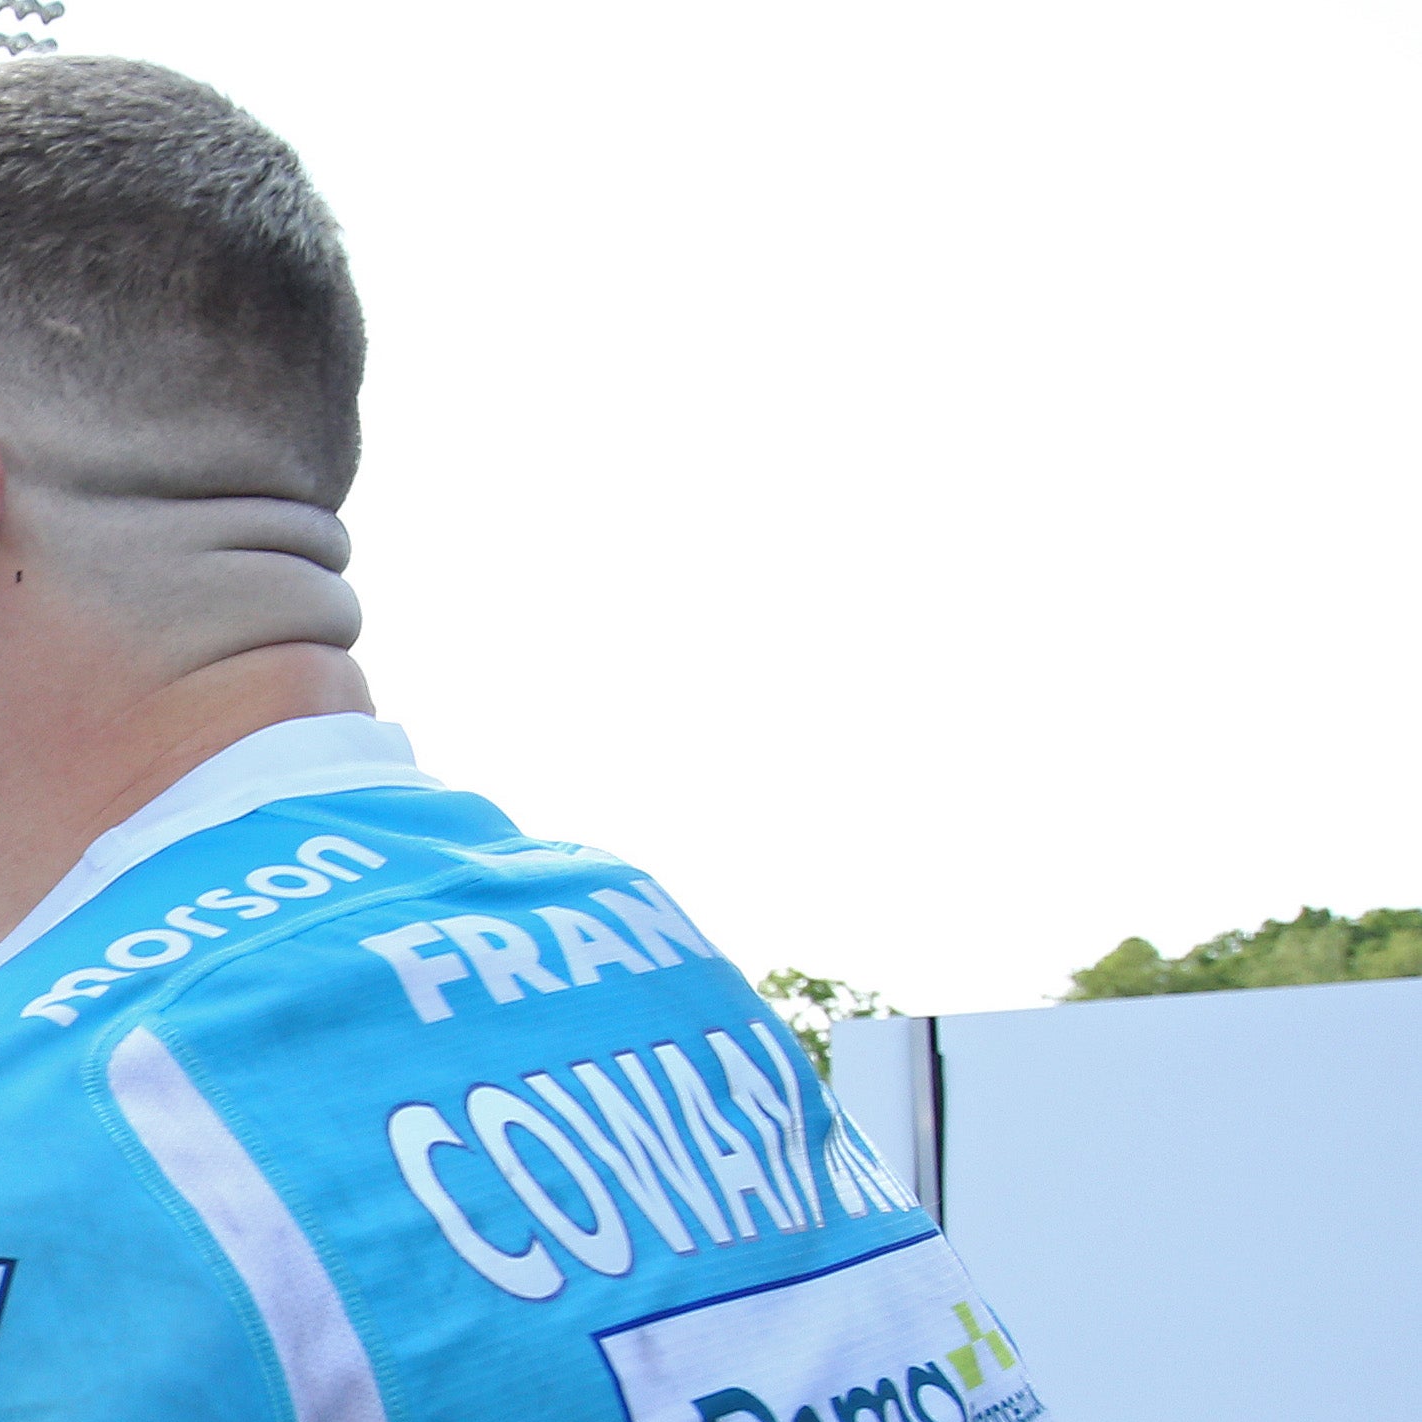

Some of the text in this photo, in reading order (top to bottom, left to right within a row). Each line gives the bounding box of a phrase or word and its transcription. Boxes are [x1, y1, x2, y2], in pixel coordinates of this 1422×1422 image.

[21, 833, 387, 1027] morson
[358, 878, 715, 1024] FRAN
[386, 1019, 923, 1300] COWAN
